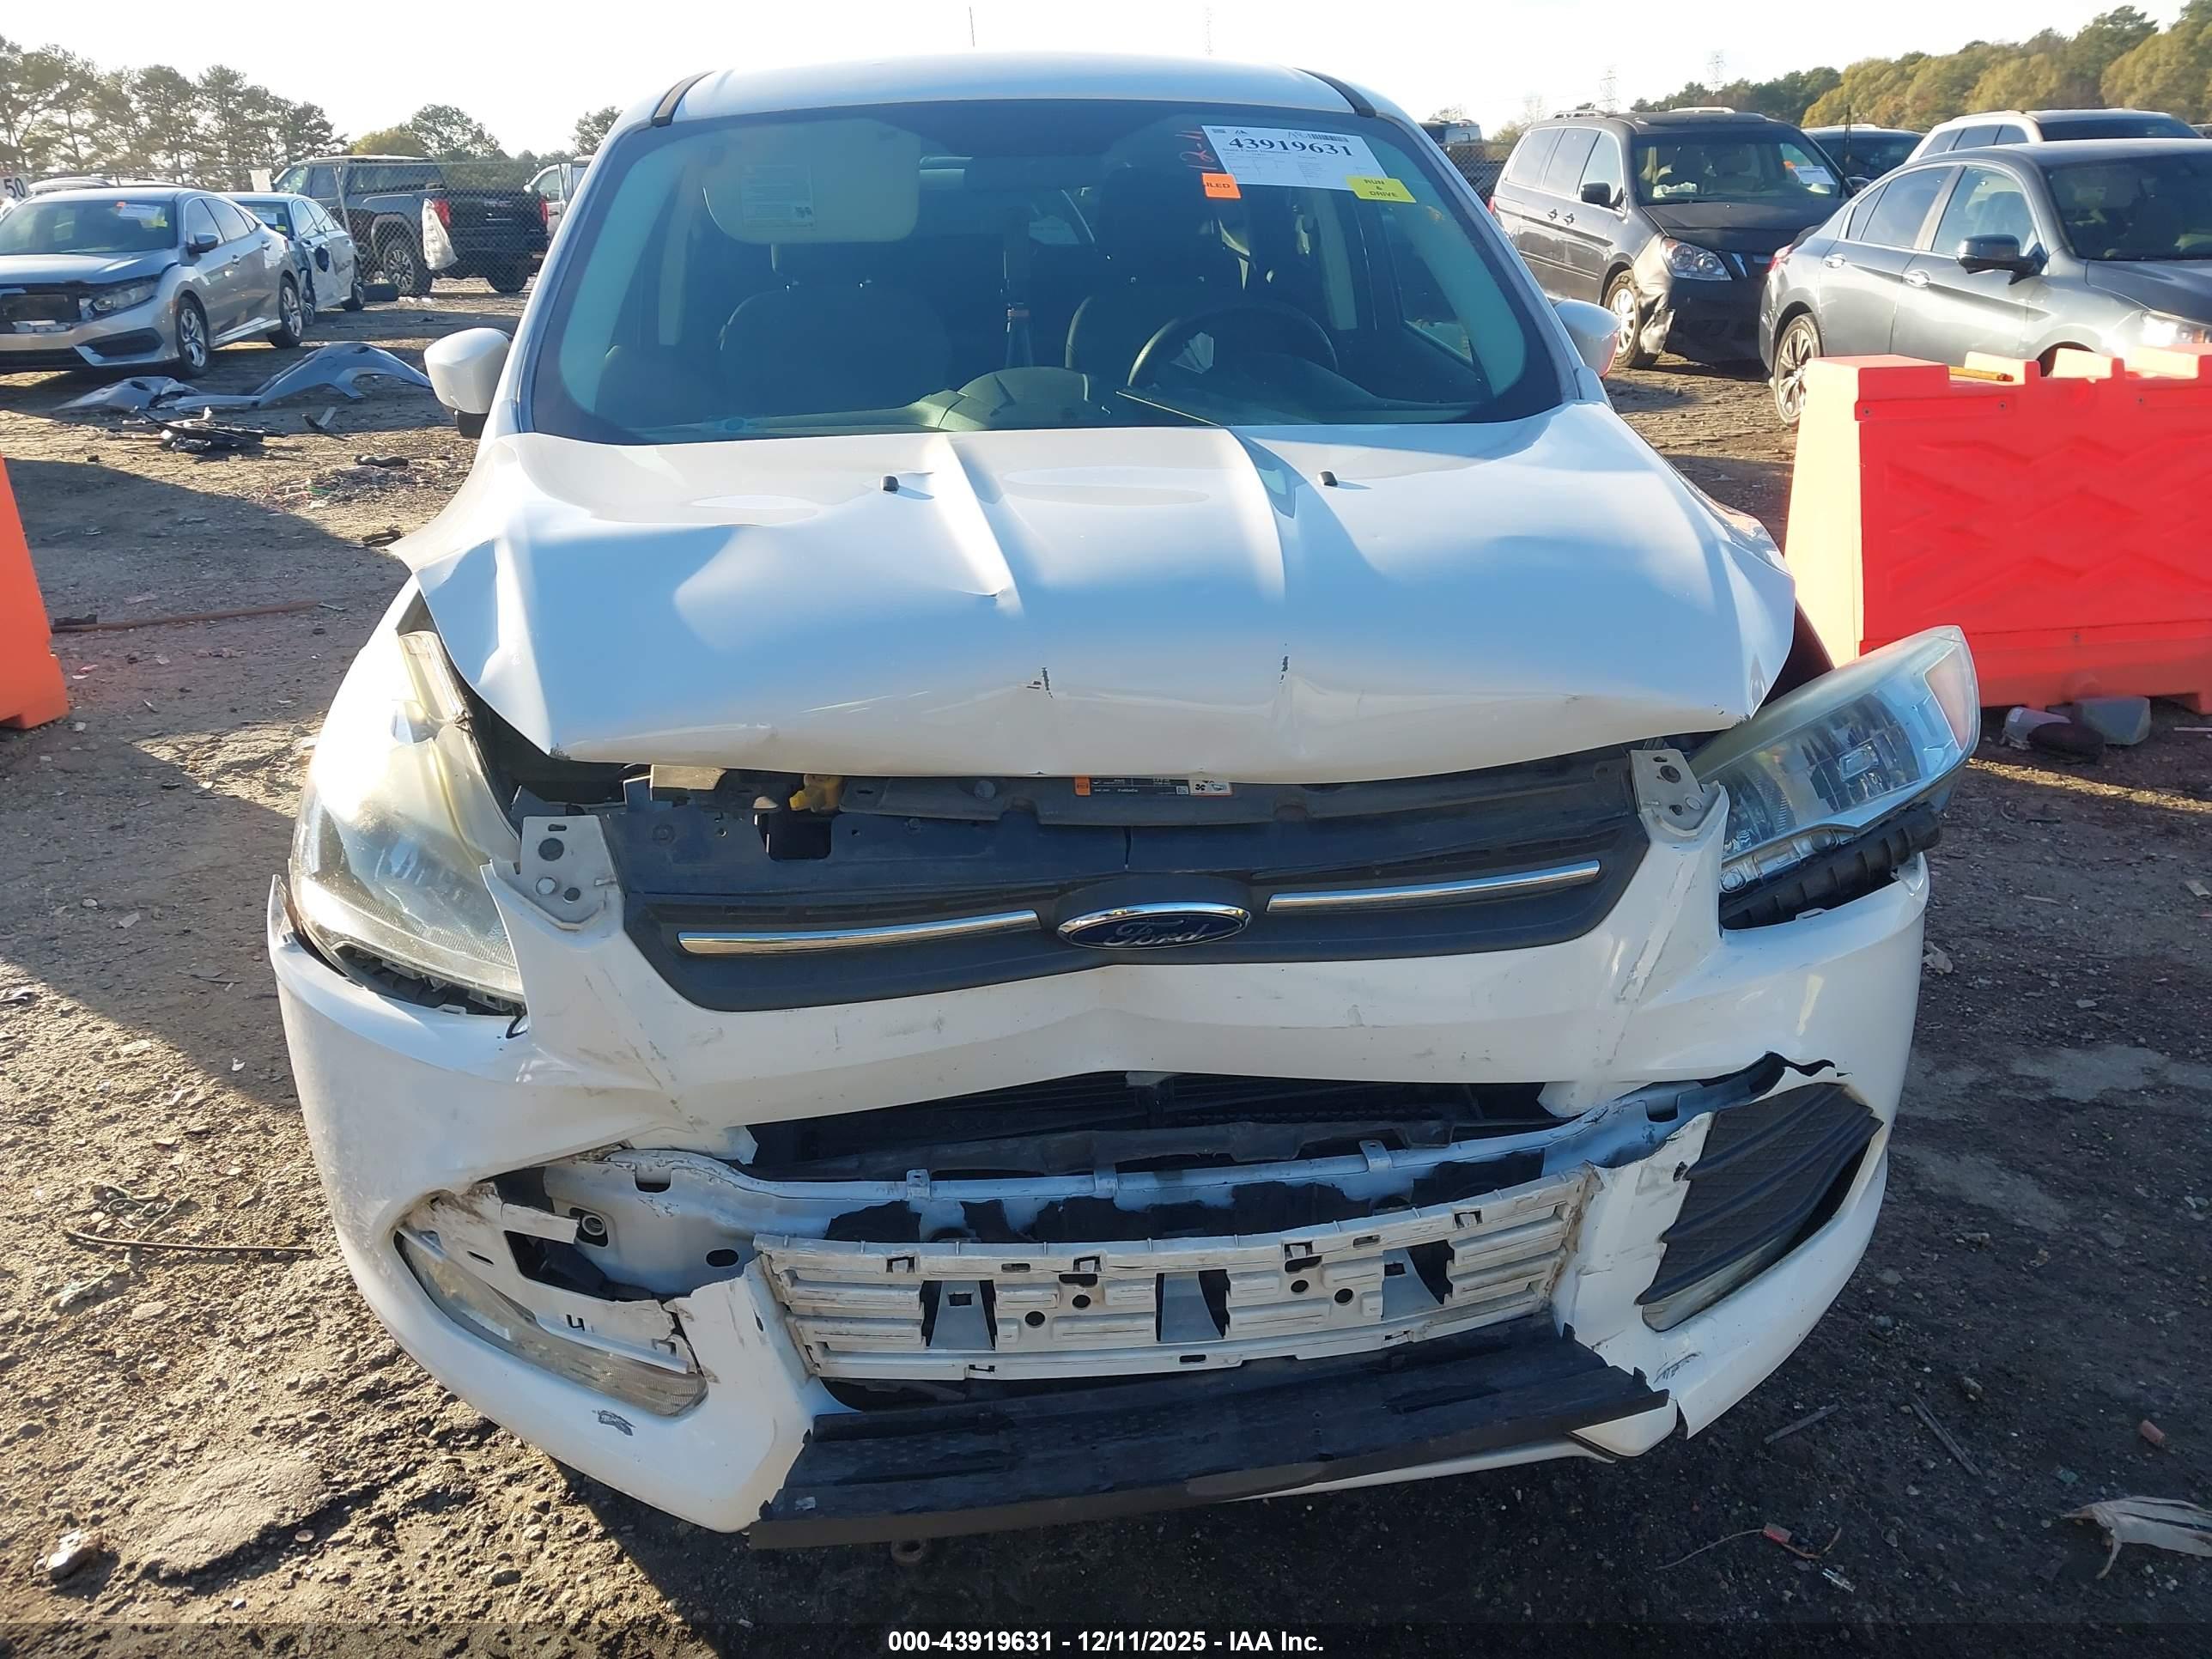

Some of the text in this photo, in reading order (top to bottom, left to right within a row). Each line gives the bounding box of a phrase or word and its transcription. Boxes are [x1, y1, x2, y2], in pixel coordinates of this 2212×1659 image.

[1229, 137, 1352, 156] 43919631
[3, 177, 26, 199] 50
[1103, 918, 1210, 946] Ford
